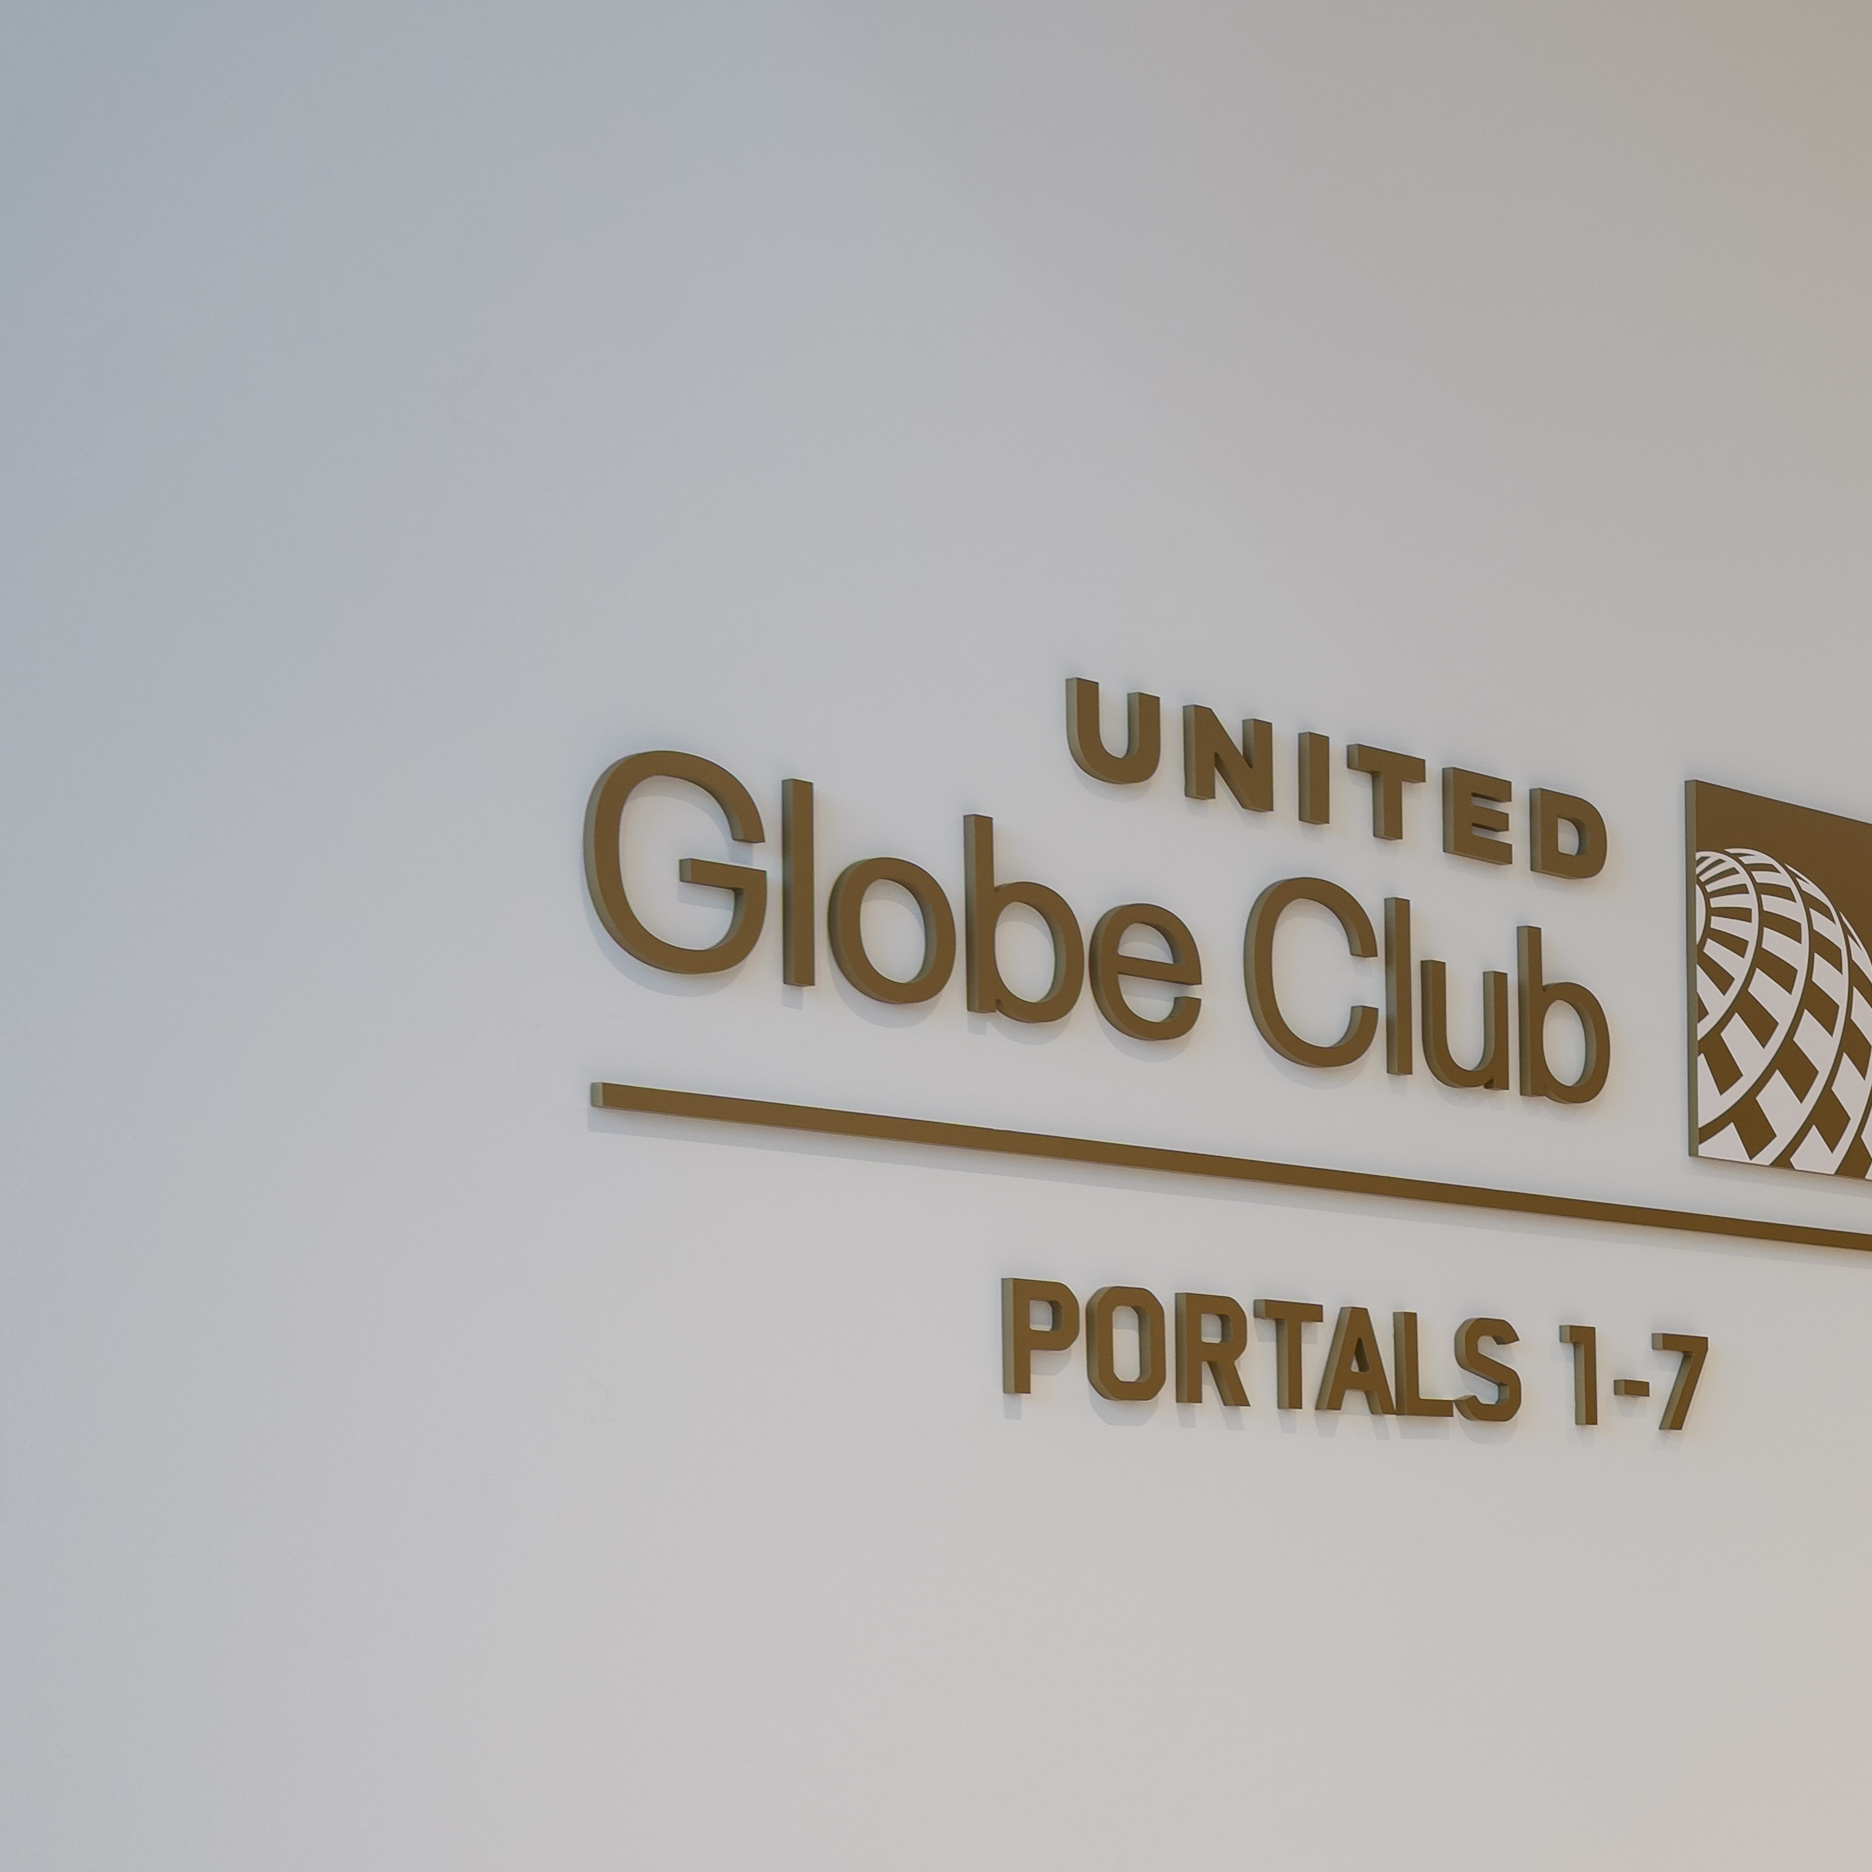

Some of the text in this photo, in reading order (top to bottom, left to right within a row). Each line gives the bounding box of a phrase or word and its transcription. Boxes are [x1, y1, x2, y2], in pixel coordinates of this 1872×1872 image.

[1064, 676, 1609, 882] UNITED
[583, 750, 1612, 1107] Globe Club
[1001, 1277, 1710, 1432] PORTALS 1-7
